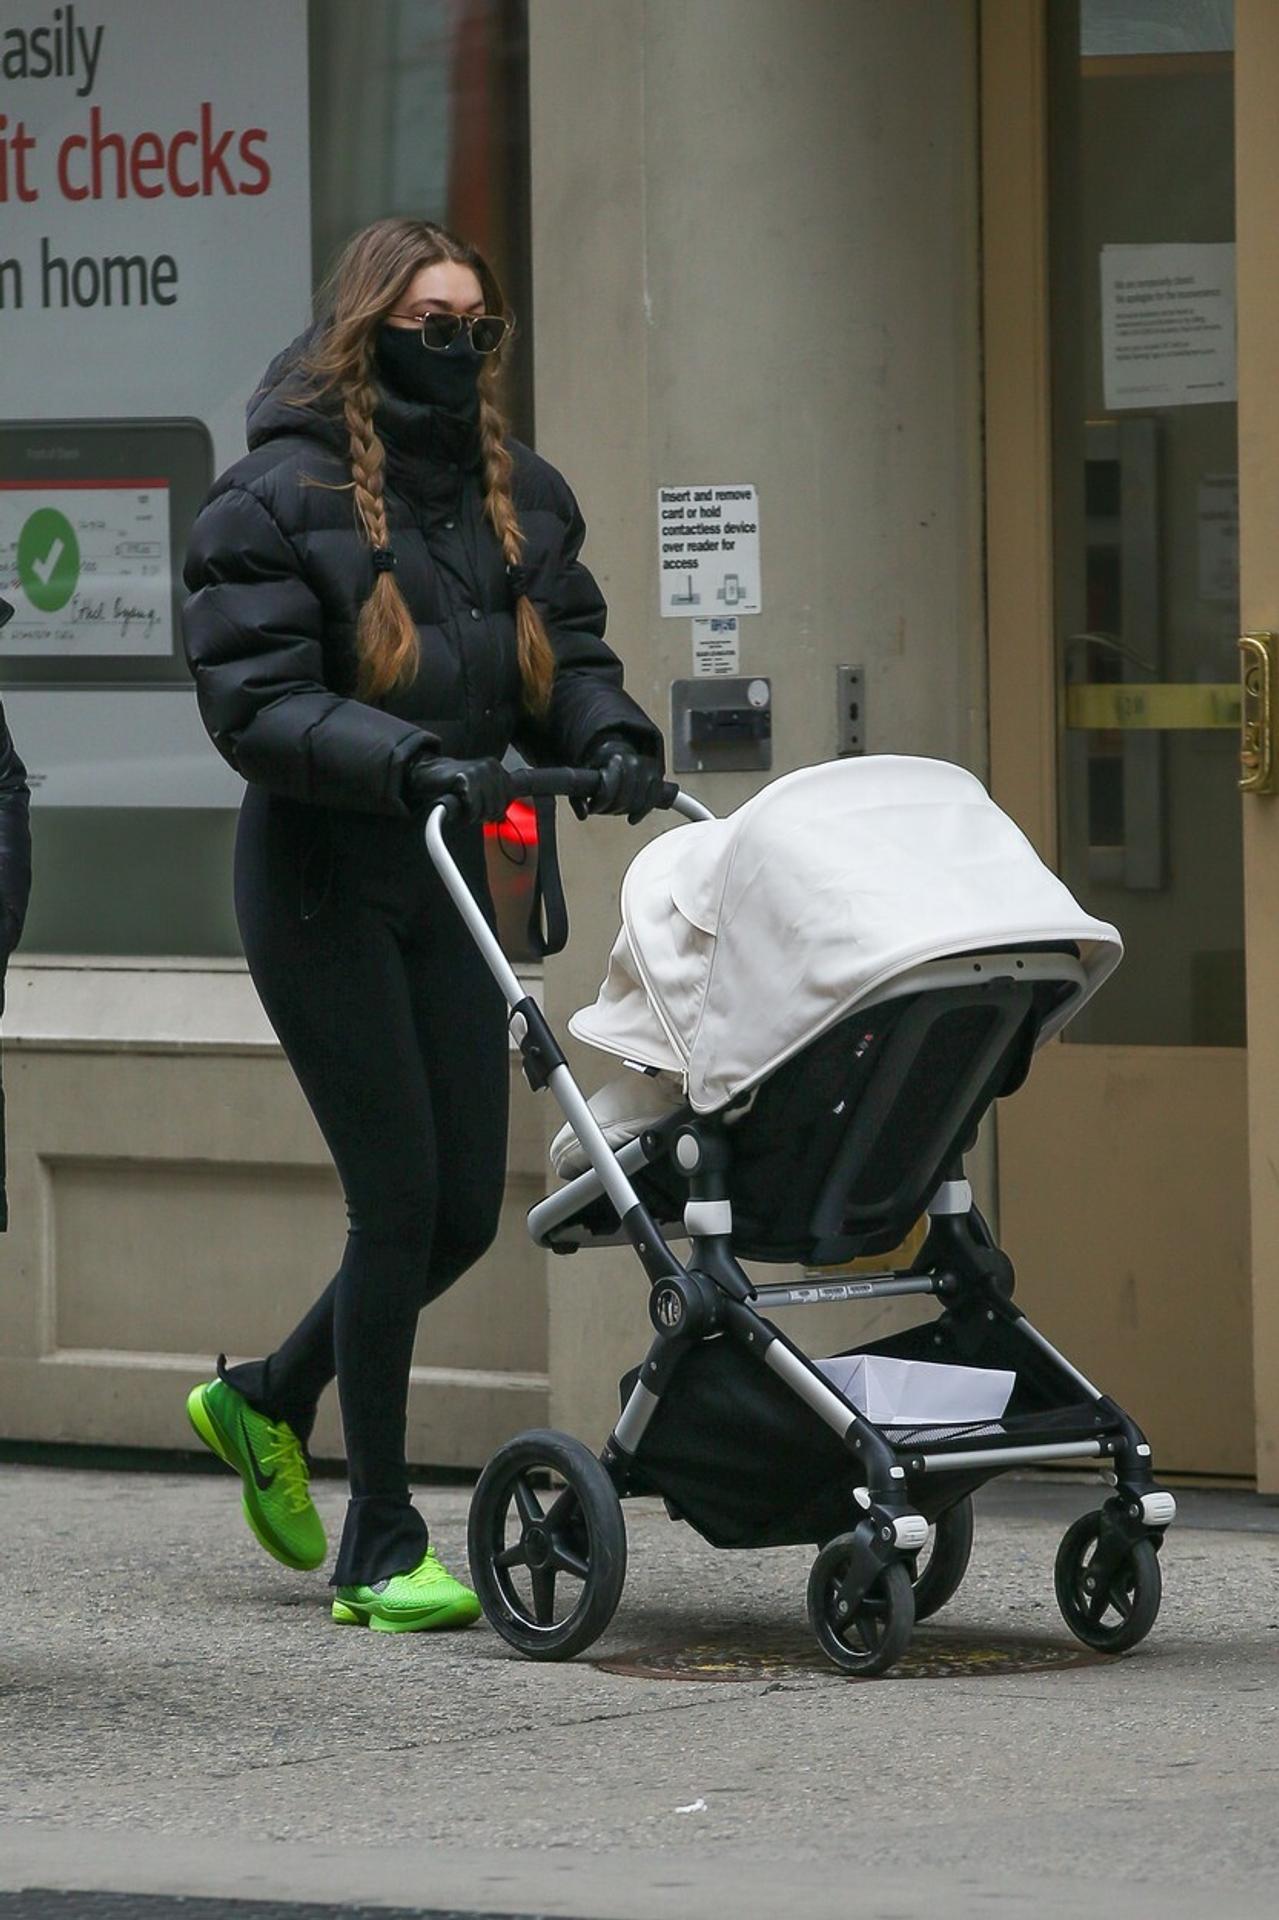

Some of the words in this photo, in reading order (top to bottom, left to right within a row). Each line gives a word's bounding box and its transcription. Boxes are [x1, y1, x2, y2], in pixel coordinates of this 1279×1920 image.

[2, 4, 104, 97] asily
[58, 102, 271, 201] checks
[41, 236, 178, 308] home
[661, 490, 691, 502] Insert
[693, 489, 712, 502] and
[715, 490, 752, 500] remove
[662, 506, 684, 519] card
[686, 508, 697, 518] or
[699, 505, 721, 518] hold
[662, 522, 721, 536] contactless
[724, 521, 757, 534] device
[662, 543, 684, 553] over
[687, 539, 720, 552] reader
[721, 538, 735, 550] for
[662, 558, 699, 570] access
